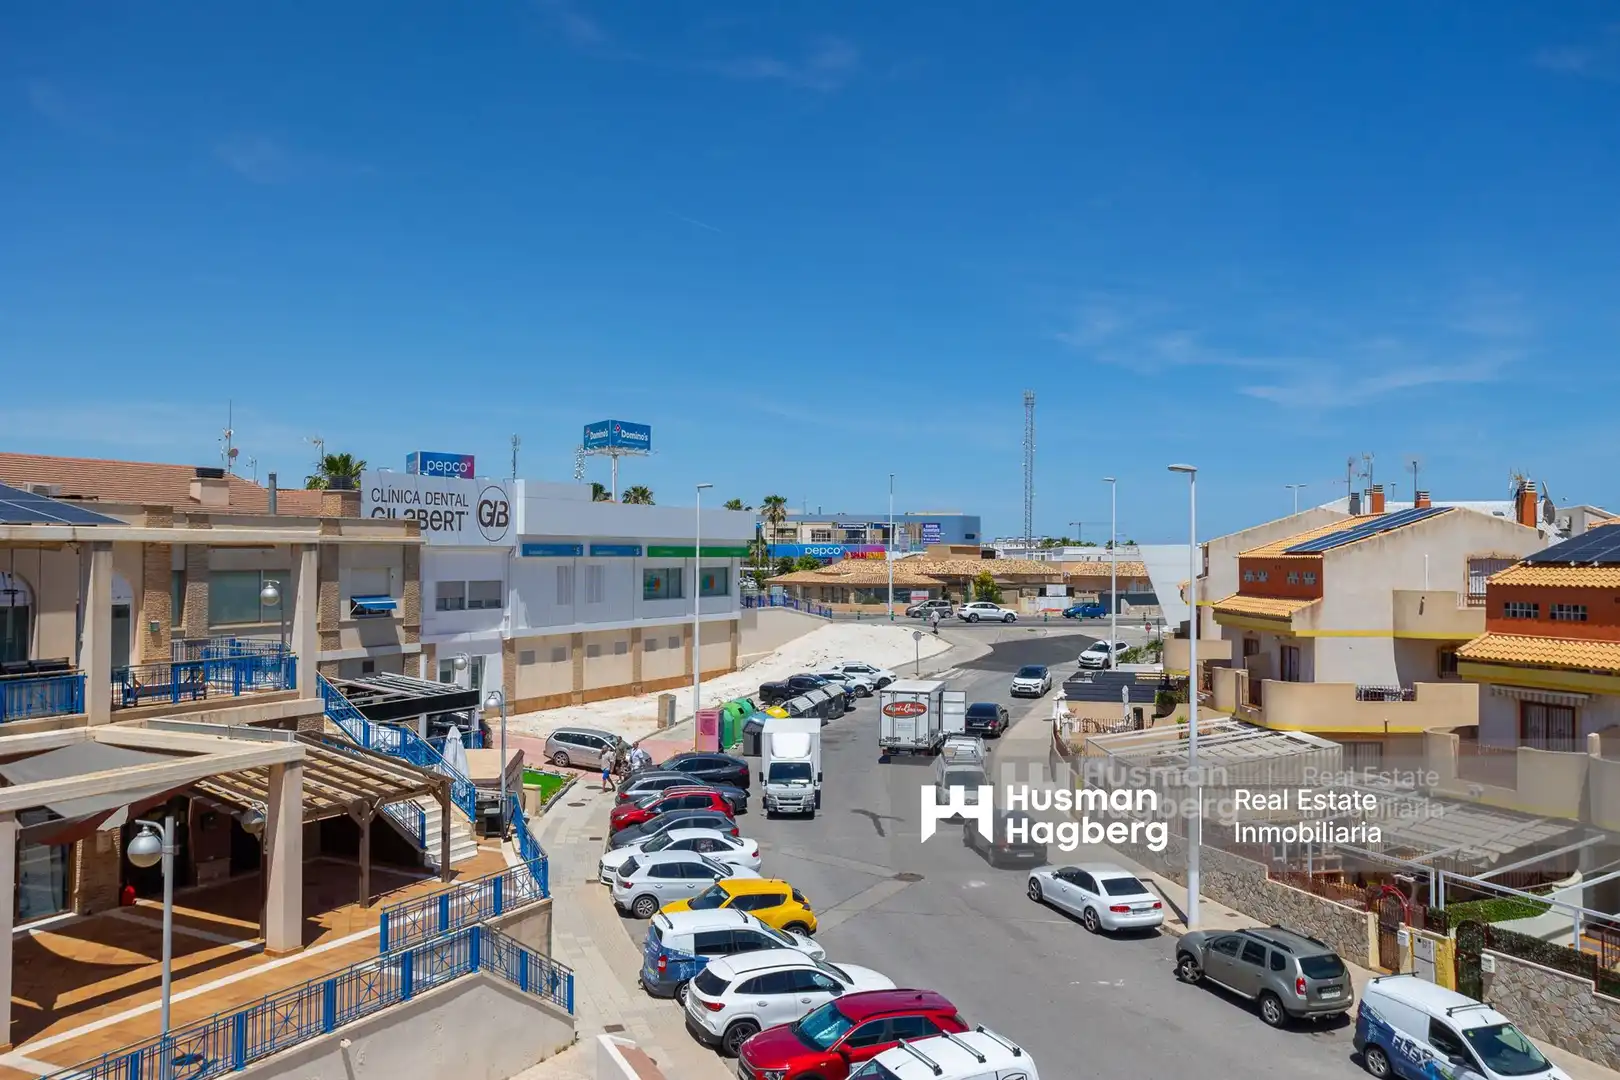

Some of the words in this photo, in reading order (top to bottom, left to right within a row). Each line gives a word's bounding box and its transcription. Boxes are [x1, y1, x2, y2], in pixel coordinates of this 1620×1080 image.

[621, 429, 649, 442] Domino's
[371, 485, 421, 505] CLÍNICA
[425, 491, 469, 507] DENTAL
